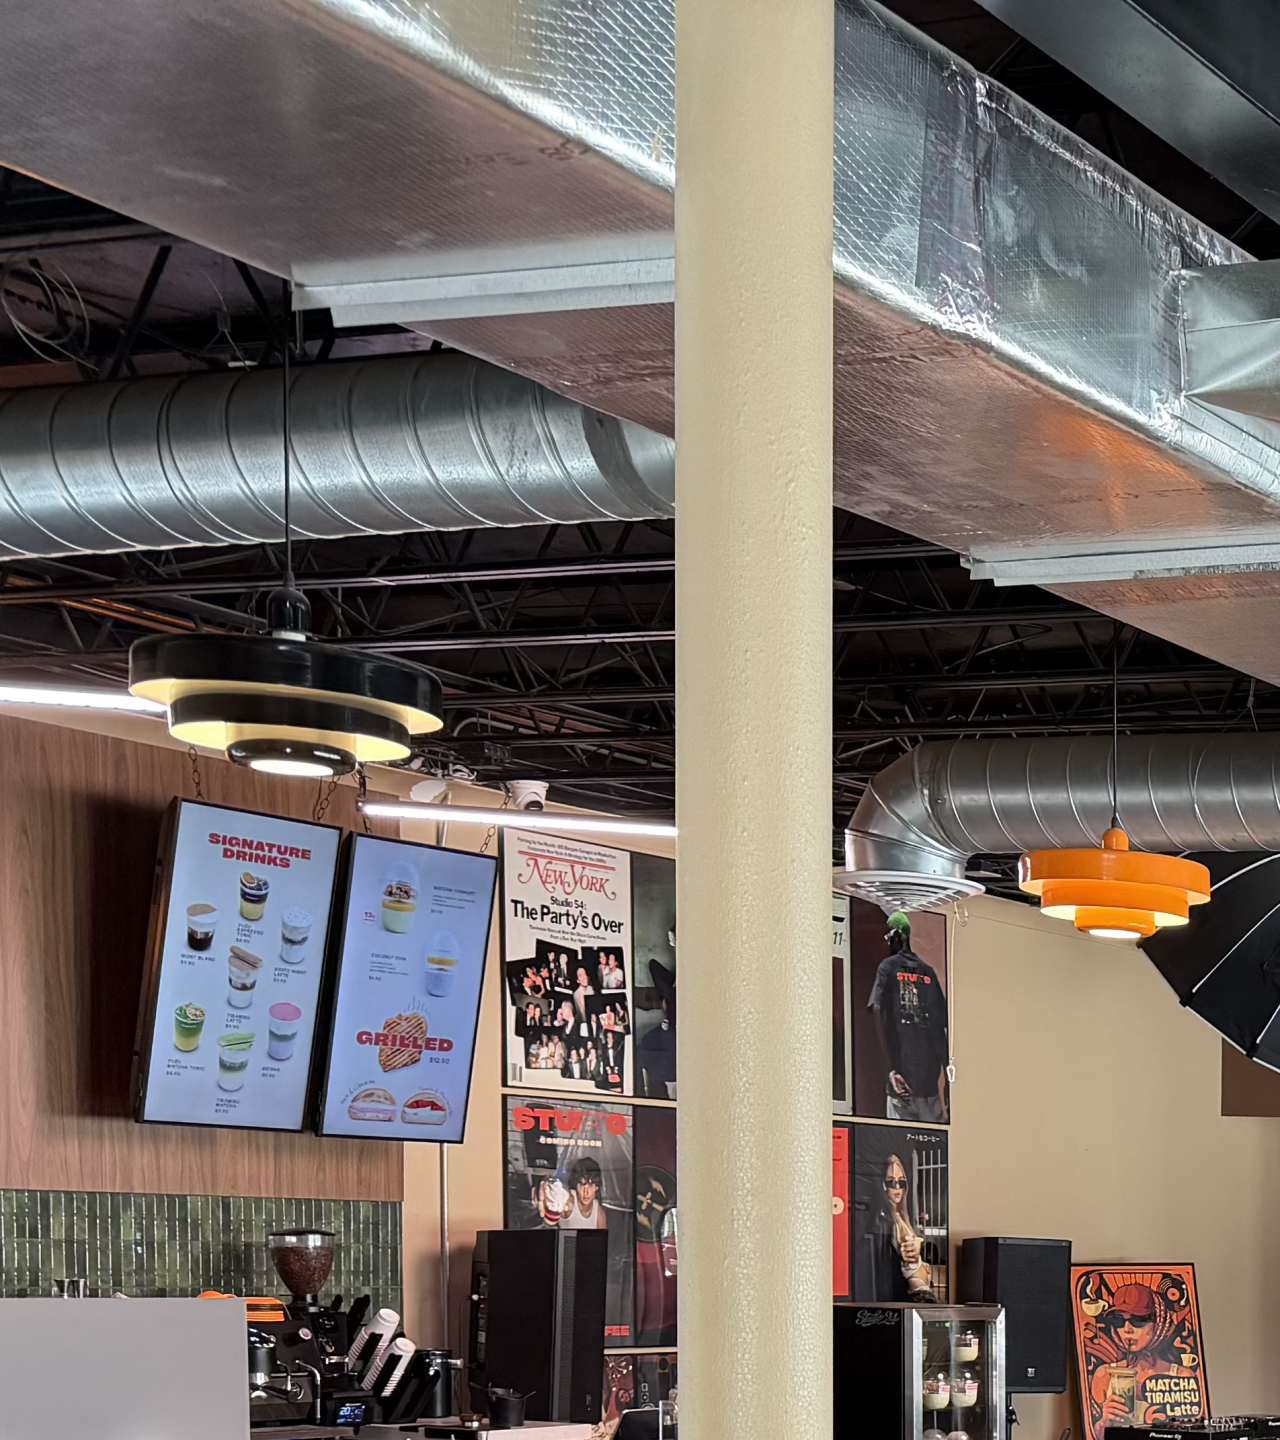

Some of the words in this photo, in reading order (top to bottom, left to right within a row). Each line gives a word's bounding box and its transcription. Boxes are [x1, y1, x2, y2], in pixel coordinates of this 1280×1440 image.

[208, 832, 312, 860] SIGNATURE
[222, 848, 291, 868] DRINKS
[550, 895, 573, 908] Studio
[510, 898, 538, 921] The
[540, 904, 589, 930] Party's
[591, 912, 624, 934] Over
[896, 971, 932, 985] STUO
[356, 1030, 454, 1052] GRILLED
[512, 1106, 627, 1136] STUO
[1145, 1378, 1197, 1392] MATCHA
[1145, 1390, 1200, 1404] TIRAMISU
[1166, 1403, 1200, 1416] Latte
